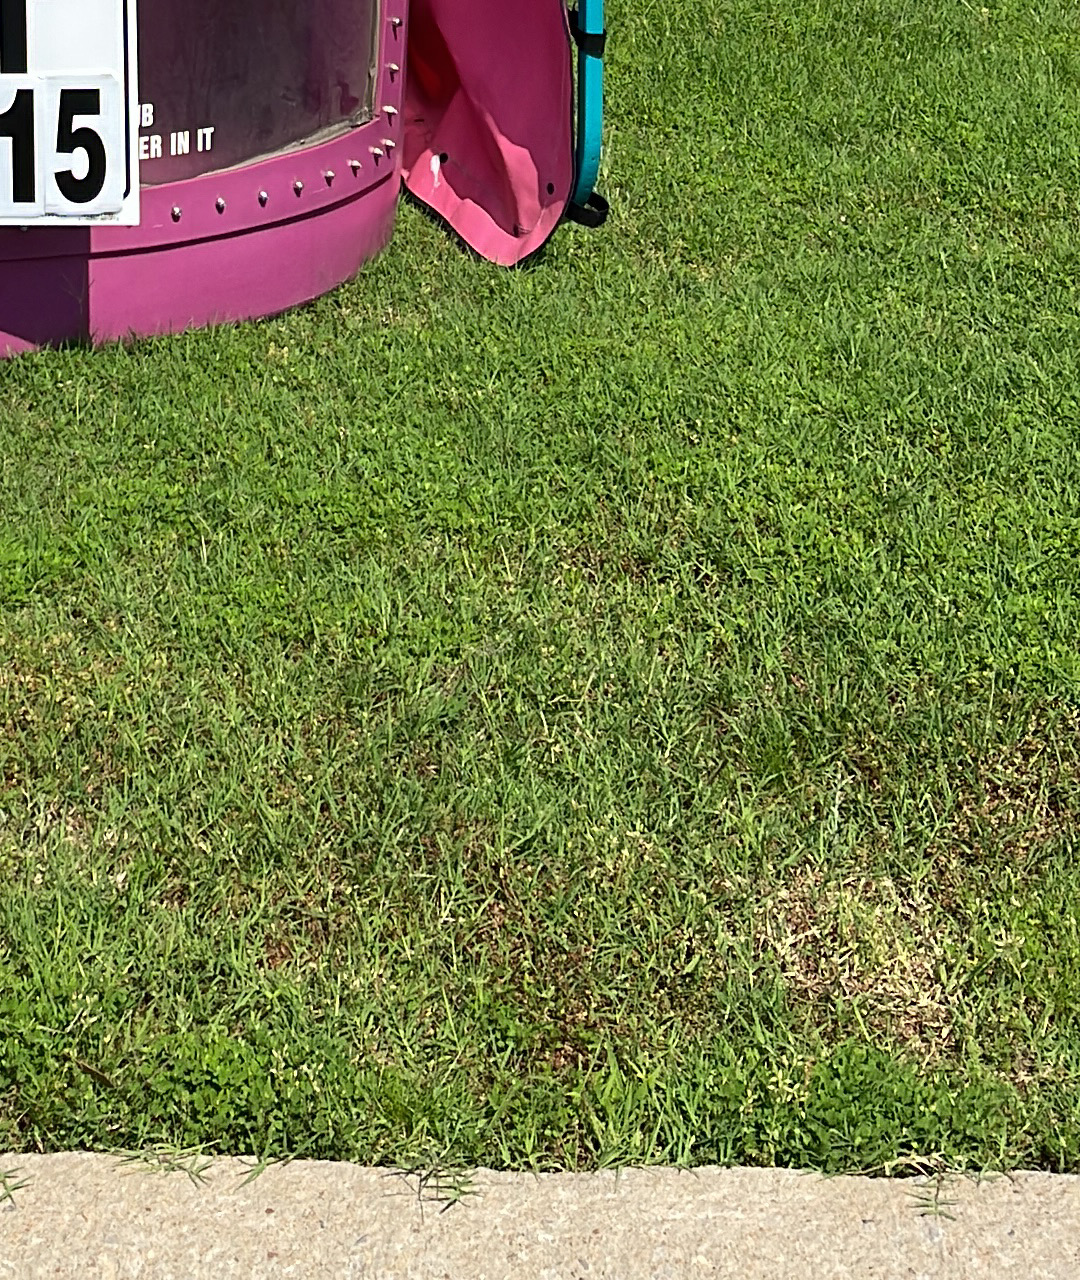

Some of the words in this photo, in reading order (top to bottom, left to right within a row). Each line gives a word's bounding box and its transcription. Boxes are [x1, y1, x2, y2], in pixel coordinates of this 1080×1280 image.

[138, 103, 154, 128] B
[170, 130, 190, 156] IN
[197, 126, 215, 152] IT
